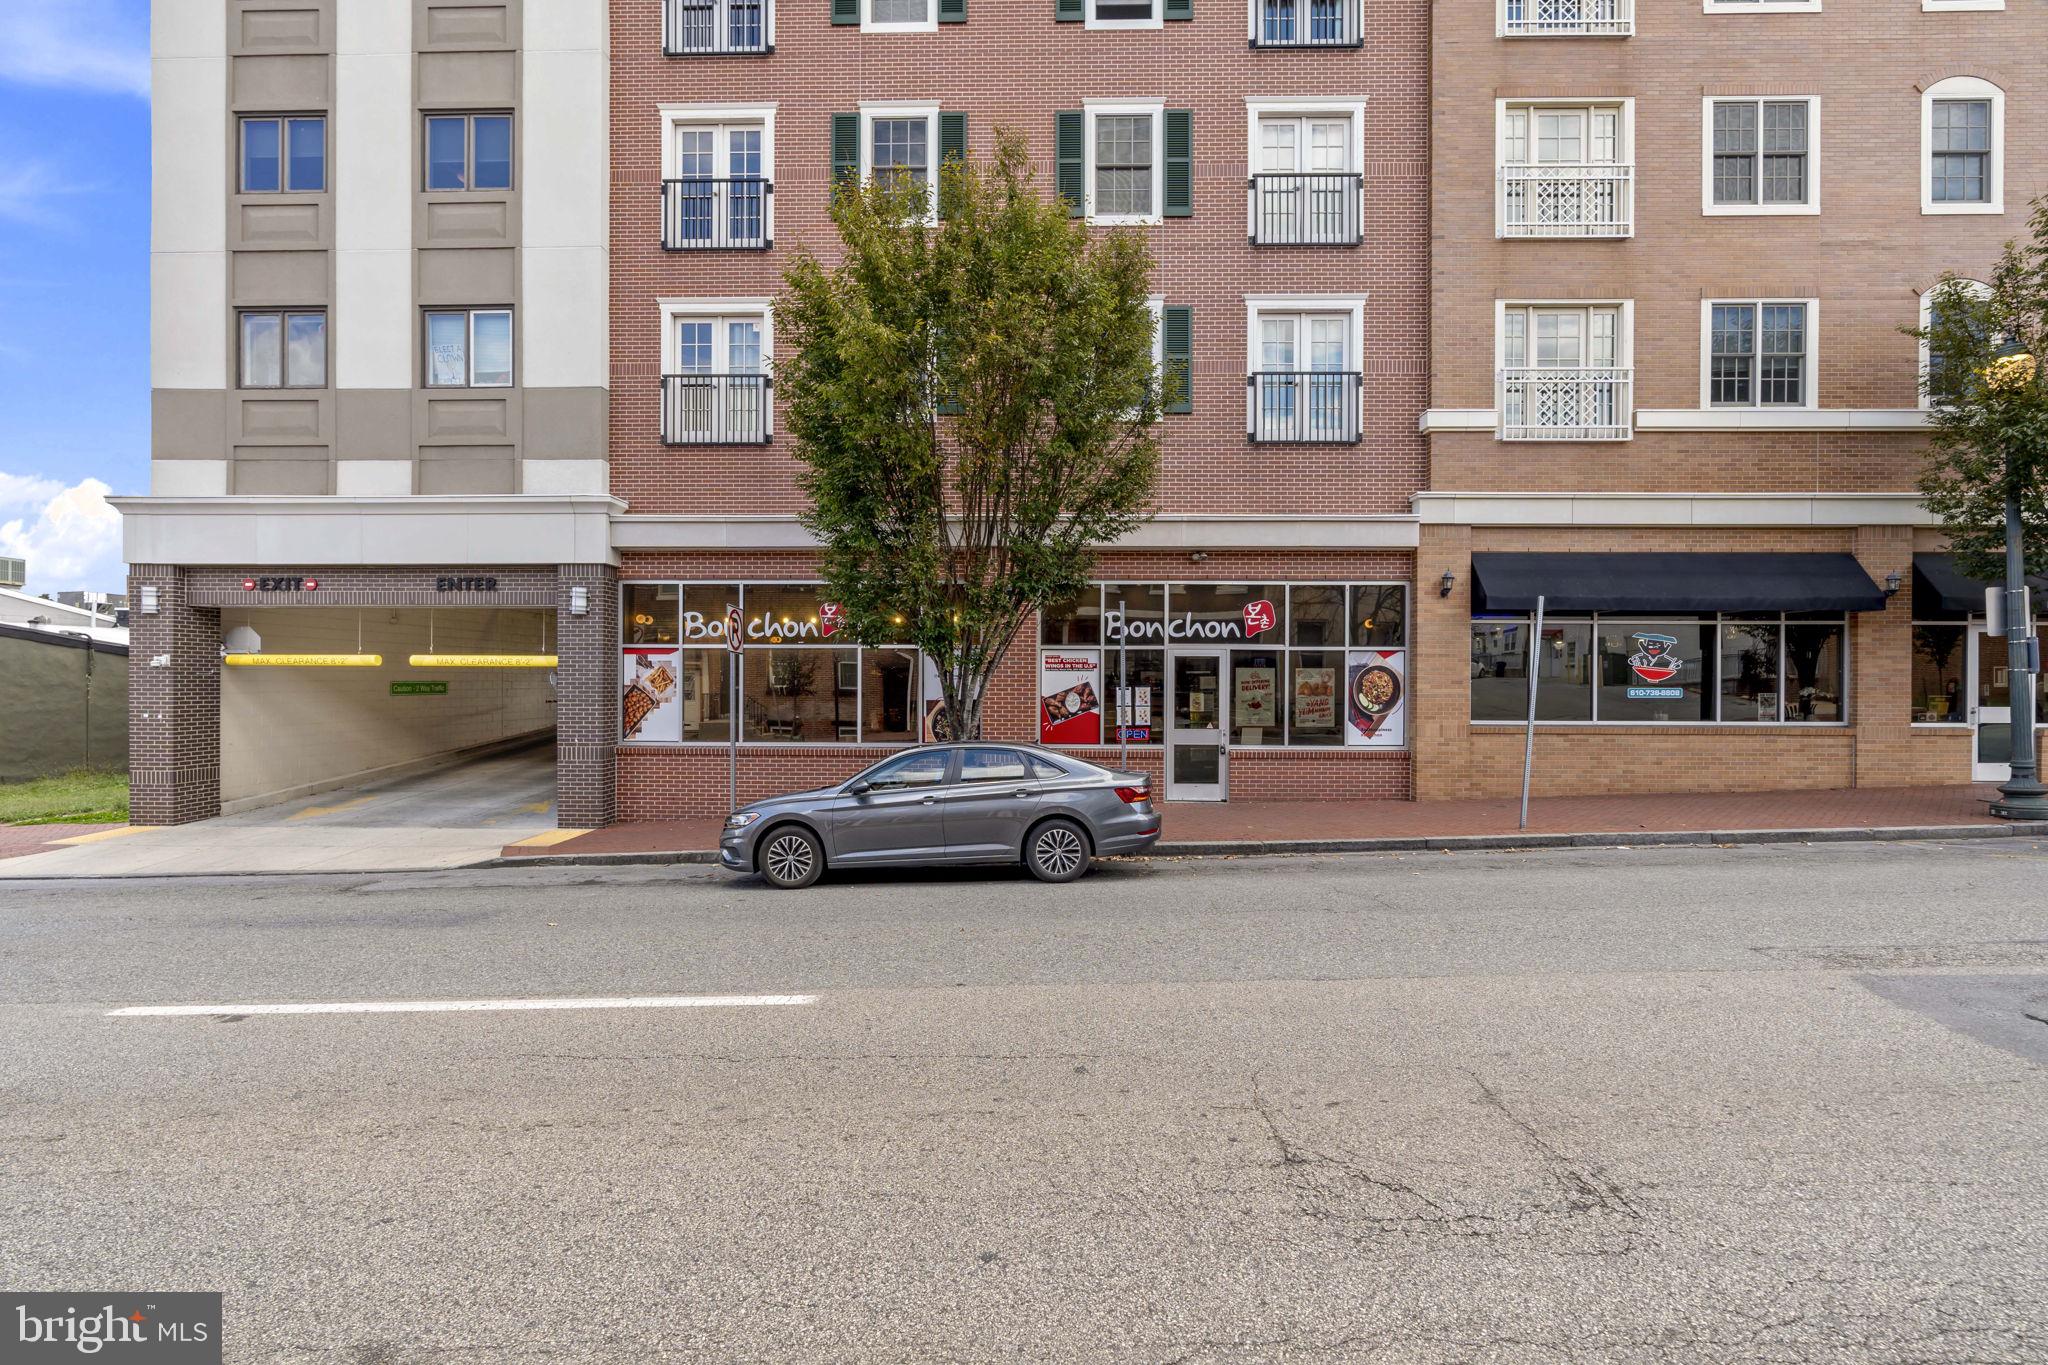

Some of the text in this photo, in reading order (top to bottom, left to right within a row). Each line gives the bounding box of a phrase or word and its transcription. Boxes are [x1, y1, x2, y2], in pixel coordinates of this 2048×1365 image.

[260, 577, 303, 592] EXIT
[436, 576, 498, 592] ENTER
[1104, 611, 1241, 639] Bonchon
[276, 657, 328, 665] CLEARANCE
[460, 658, 513, 666] CLEARANCE
